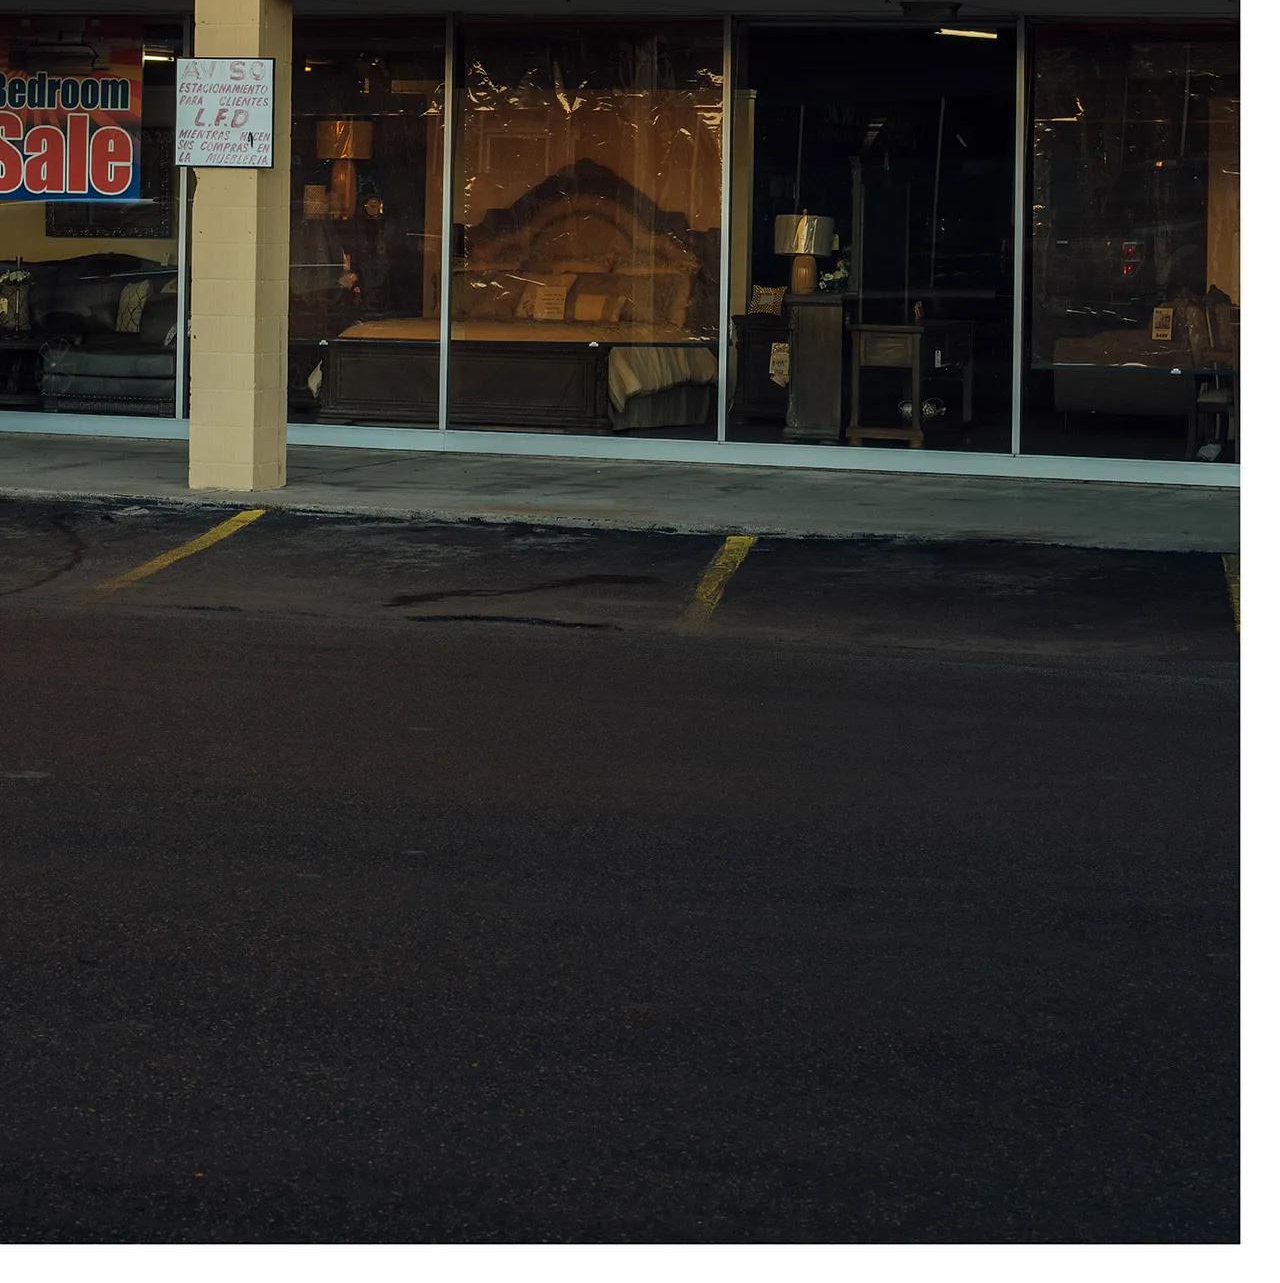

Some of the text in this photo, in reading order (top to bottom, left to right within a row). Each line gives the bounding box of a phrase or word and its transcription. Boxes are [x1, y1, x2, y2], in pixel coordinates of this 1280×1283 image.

[181, 60, 266, 81] AVISO
[178, 82, 269, 95] ESTACIONAMIENTO
[179, 95, 269, 107] PARA CLIENTES
[178, 129, 230, 141] MIENTRAS
[178, 139, 270, 153] SUS COMPRAS EN
[178, 152, 269, 165] LA MUEBLERIA
